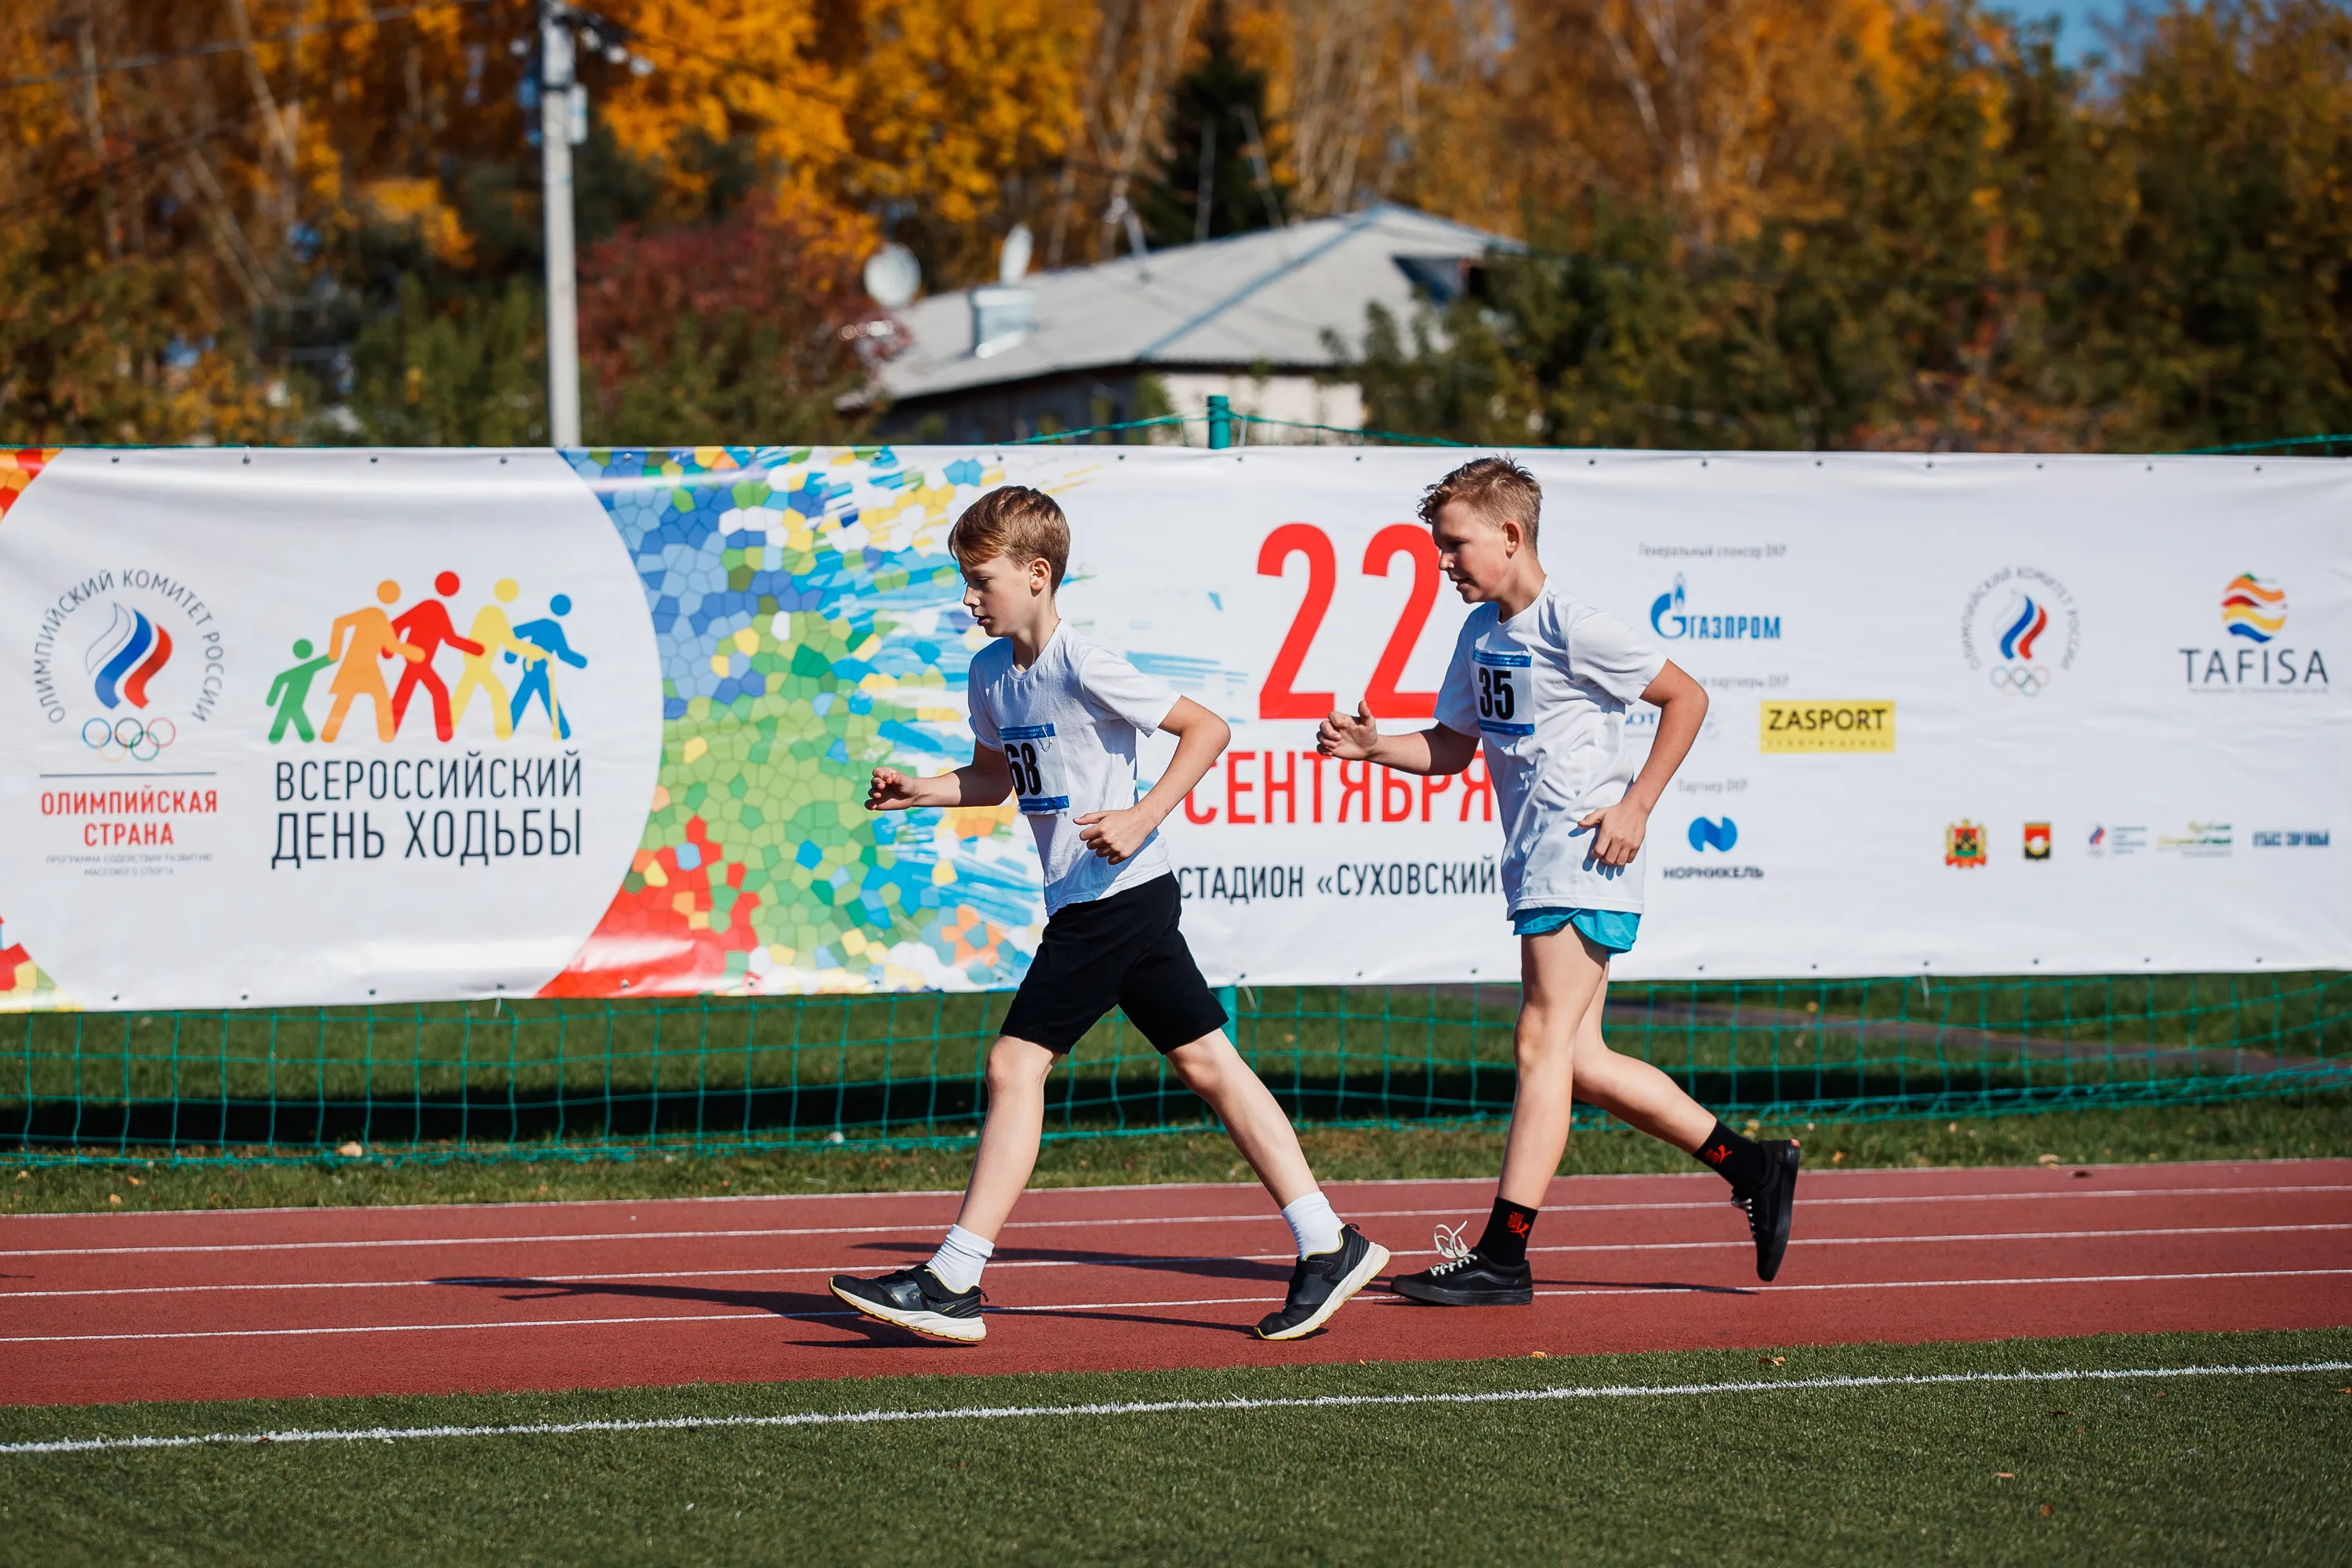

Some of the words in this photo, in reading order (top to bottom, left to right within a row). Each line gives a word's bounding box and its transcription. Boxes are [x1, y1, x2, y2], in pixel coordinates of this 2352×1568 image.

[34, 569, 114, 724] ОЛИМПИЙСКИЙ
[123, 568, 212, 626] КОМИТЕТ
[191, 630, 224, 722] РОССИИ
[1257, 523, 1442, 720] 22
[1690, 615, 1781, 640] ГАЗПРОМ
[2178, 648, 2329, 685] TAFISA
[1479, 666, 1515, 720] 35
[1769, 708, 1887, 731] ZASPORT
[276, 750, 582, 802] ВСЕРОССИЙСКИЙ
[1004, 742, 1042, 797] 68
[41, 784, 218, 816] ОЛИМПИЙСКАЯ
[84, 822, 175, 847] СТРАНА
[271, 811, 386, 869] ДЕНЬ
[405, 808, 582, 867] ХОДЬБЫ
[1178, 866, 1304, 905] СТАДИОН
[1317, 856, 1504, 896] «СУХОВСКИЙ
[1663, 866, 1765, 880] НОРНИКЕЛЬ
